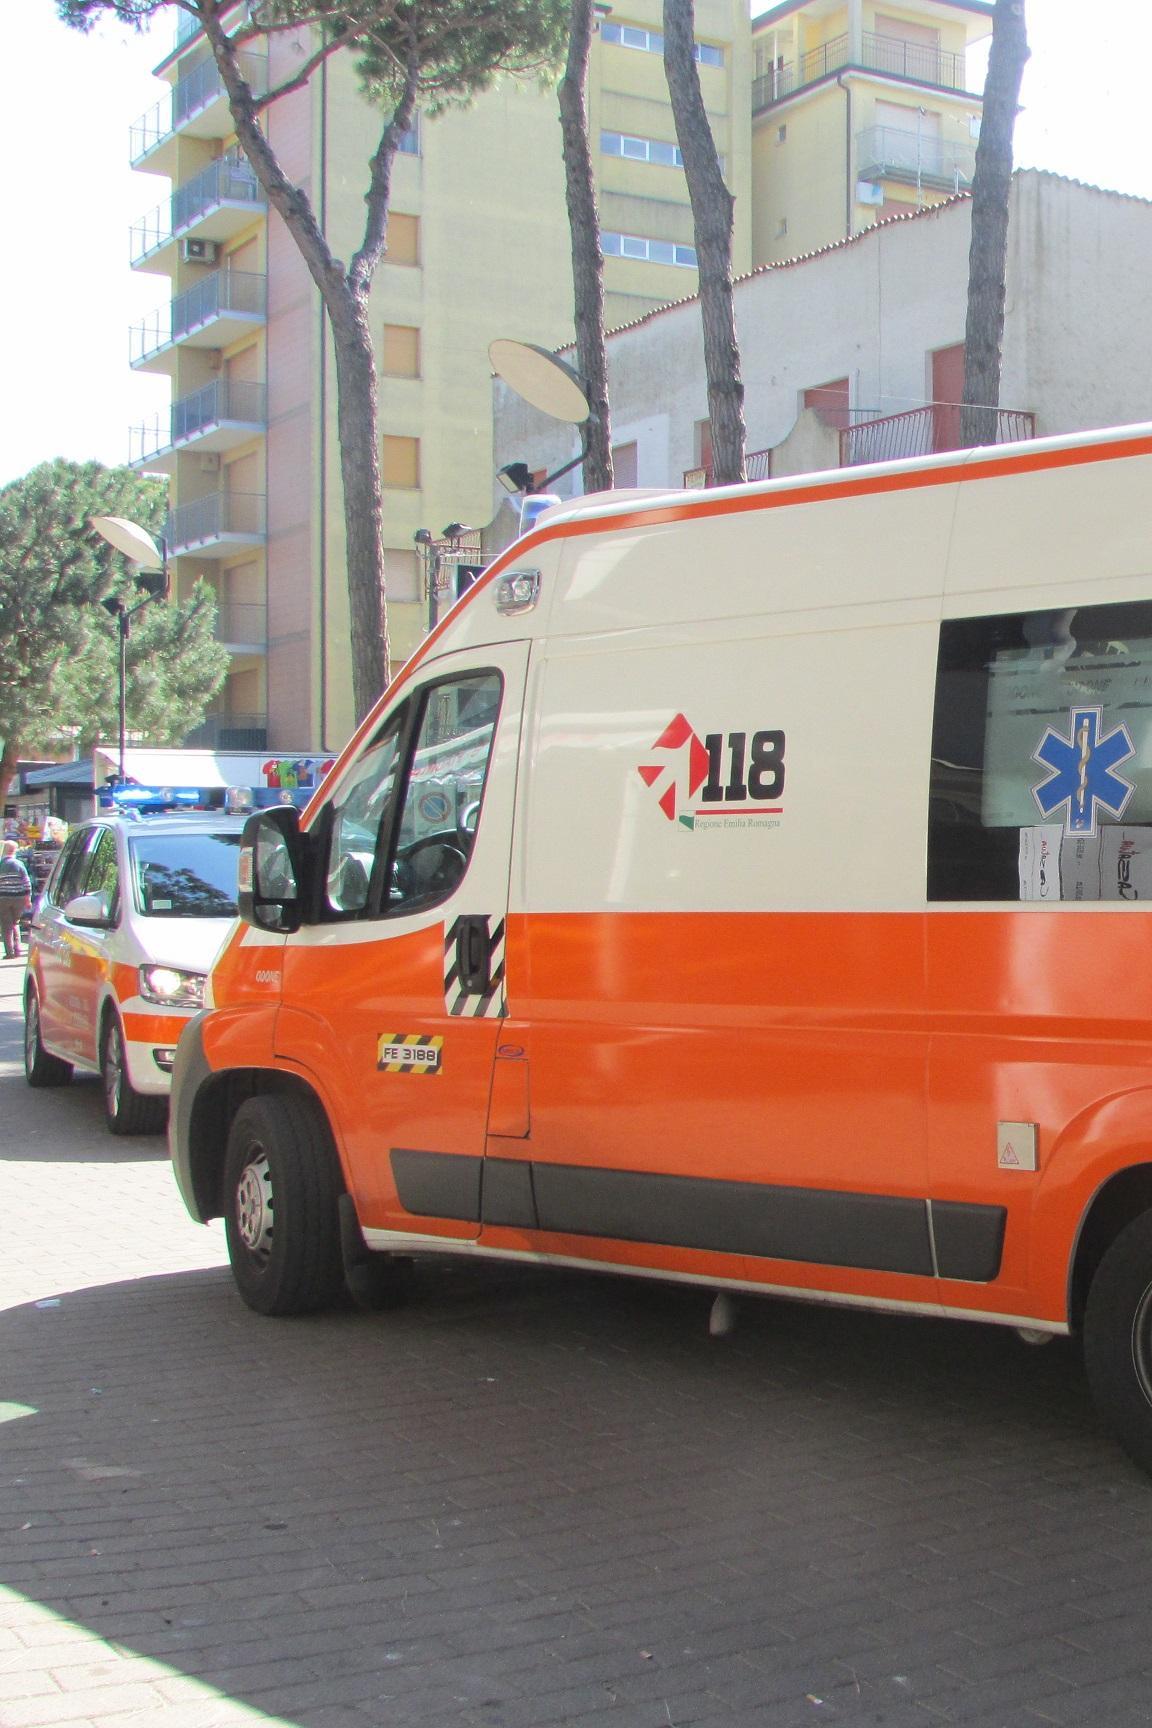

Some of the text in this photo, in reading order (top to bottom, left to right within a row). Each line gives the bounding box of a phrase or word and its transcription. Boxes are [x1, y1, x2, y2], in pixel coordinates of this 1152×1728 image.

[702, 730, 785, 802] 118
[695, 818, 781, 829] Regione Emilia Romagna
[384, 1047, 438, 1061] FE 3188
